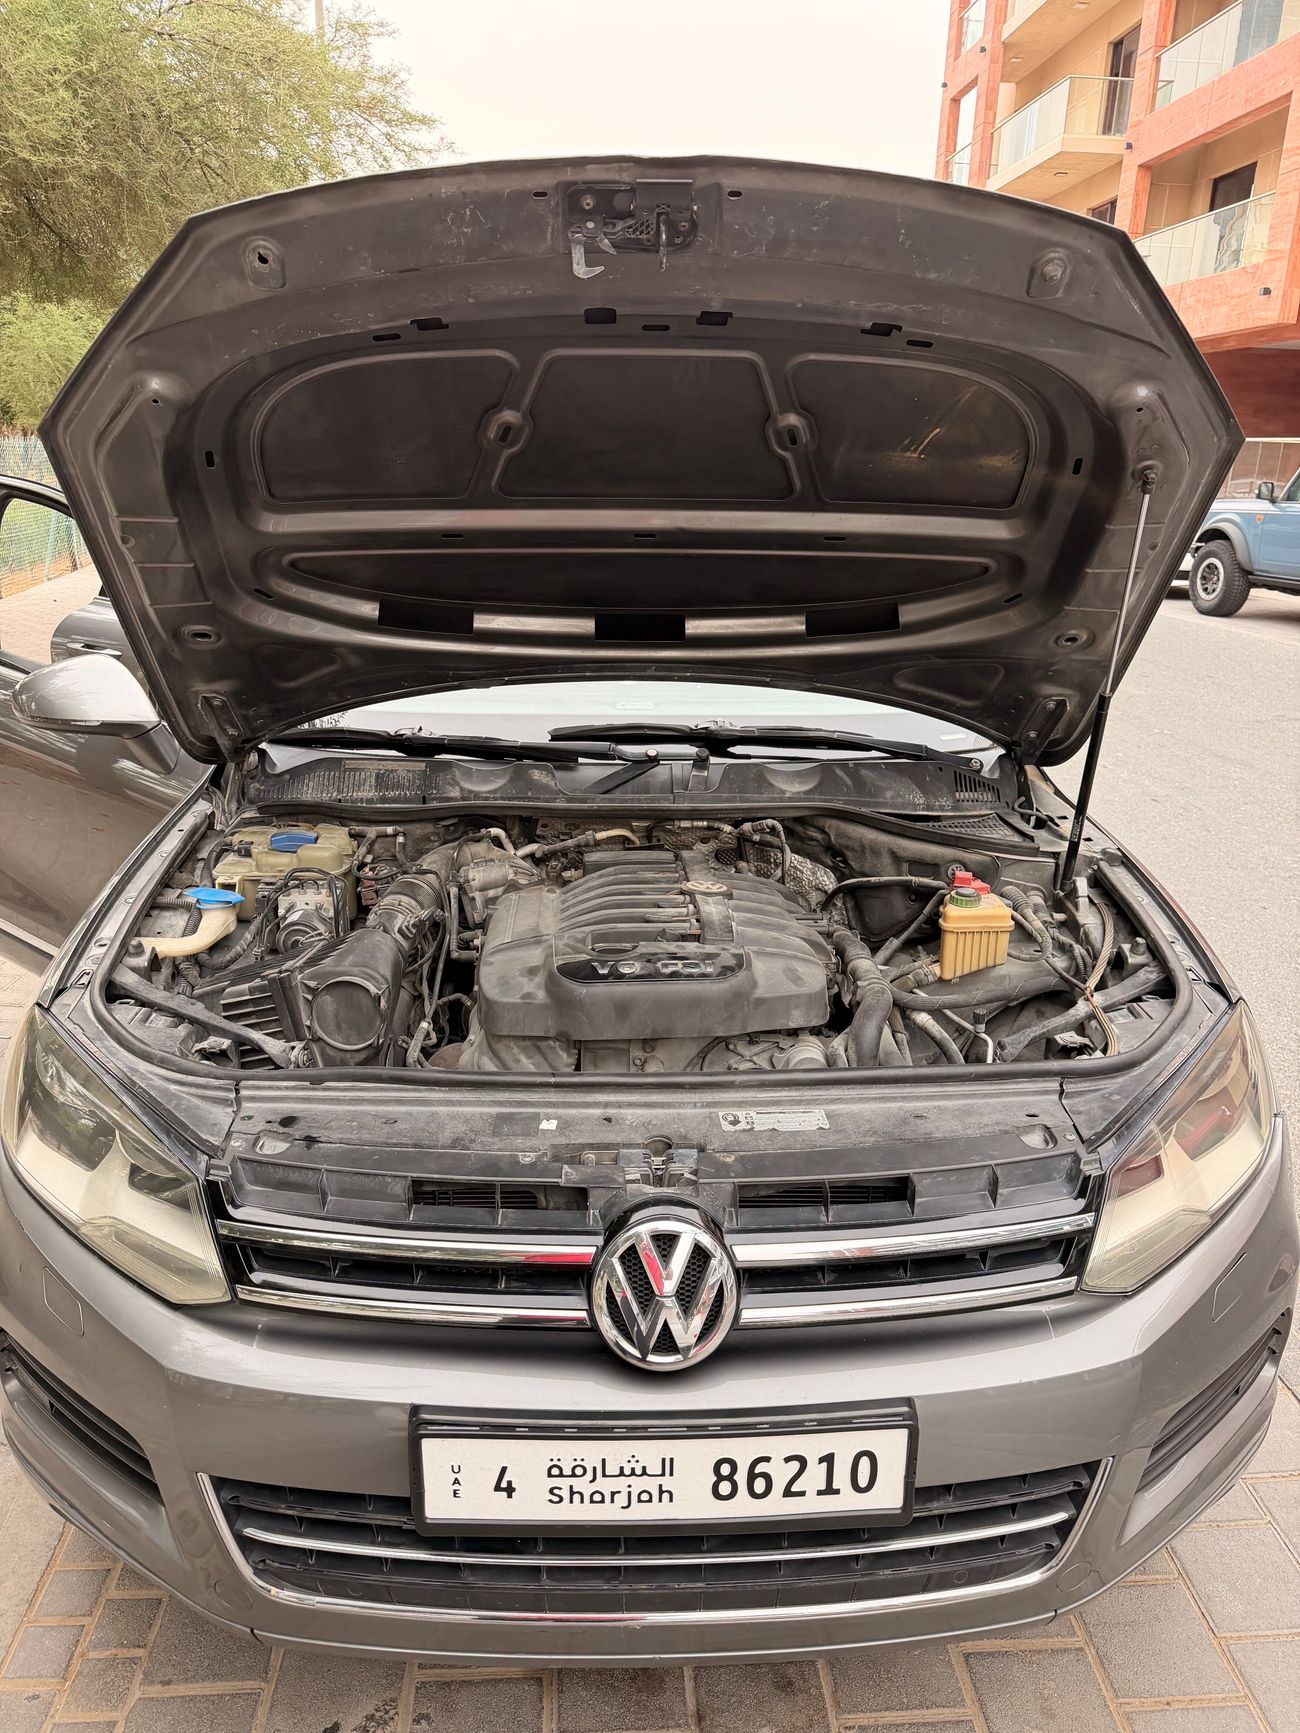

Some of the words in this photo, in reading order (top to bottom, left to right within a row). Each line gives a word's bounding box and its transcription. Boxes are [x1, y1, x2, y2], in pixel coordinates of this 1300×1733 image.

[592, 961, 637, 974] V6
[493, 1465, 517, 1499] 4
[546, 1454, 675, 1484] الشارقة
[711, 1449, 879, 1502] 86210
[547, 1484, 674, 1509] Sharjah
